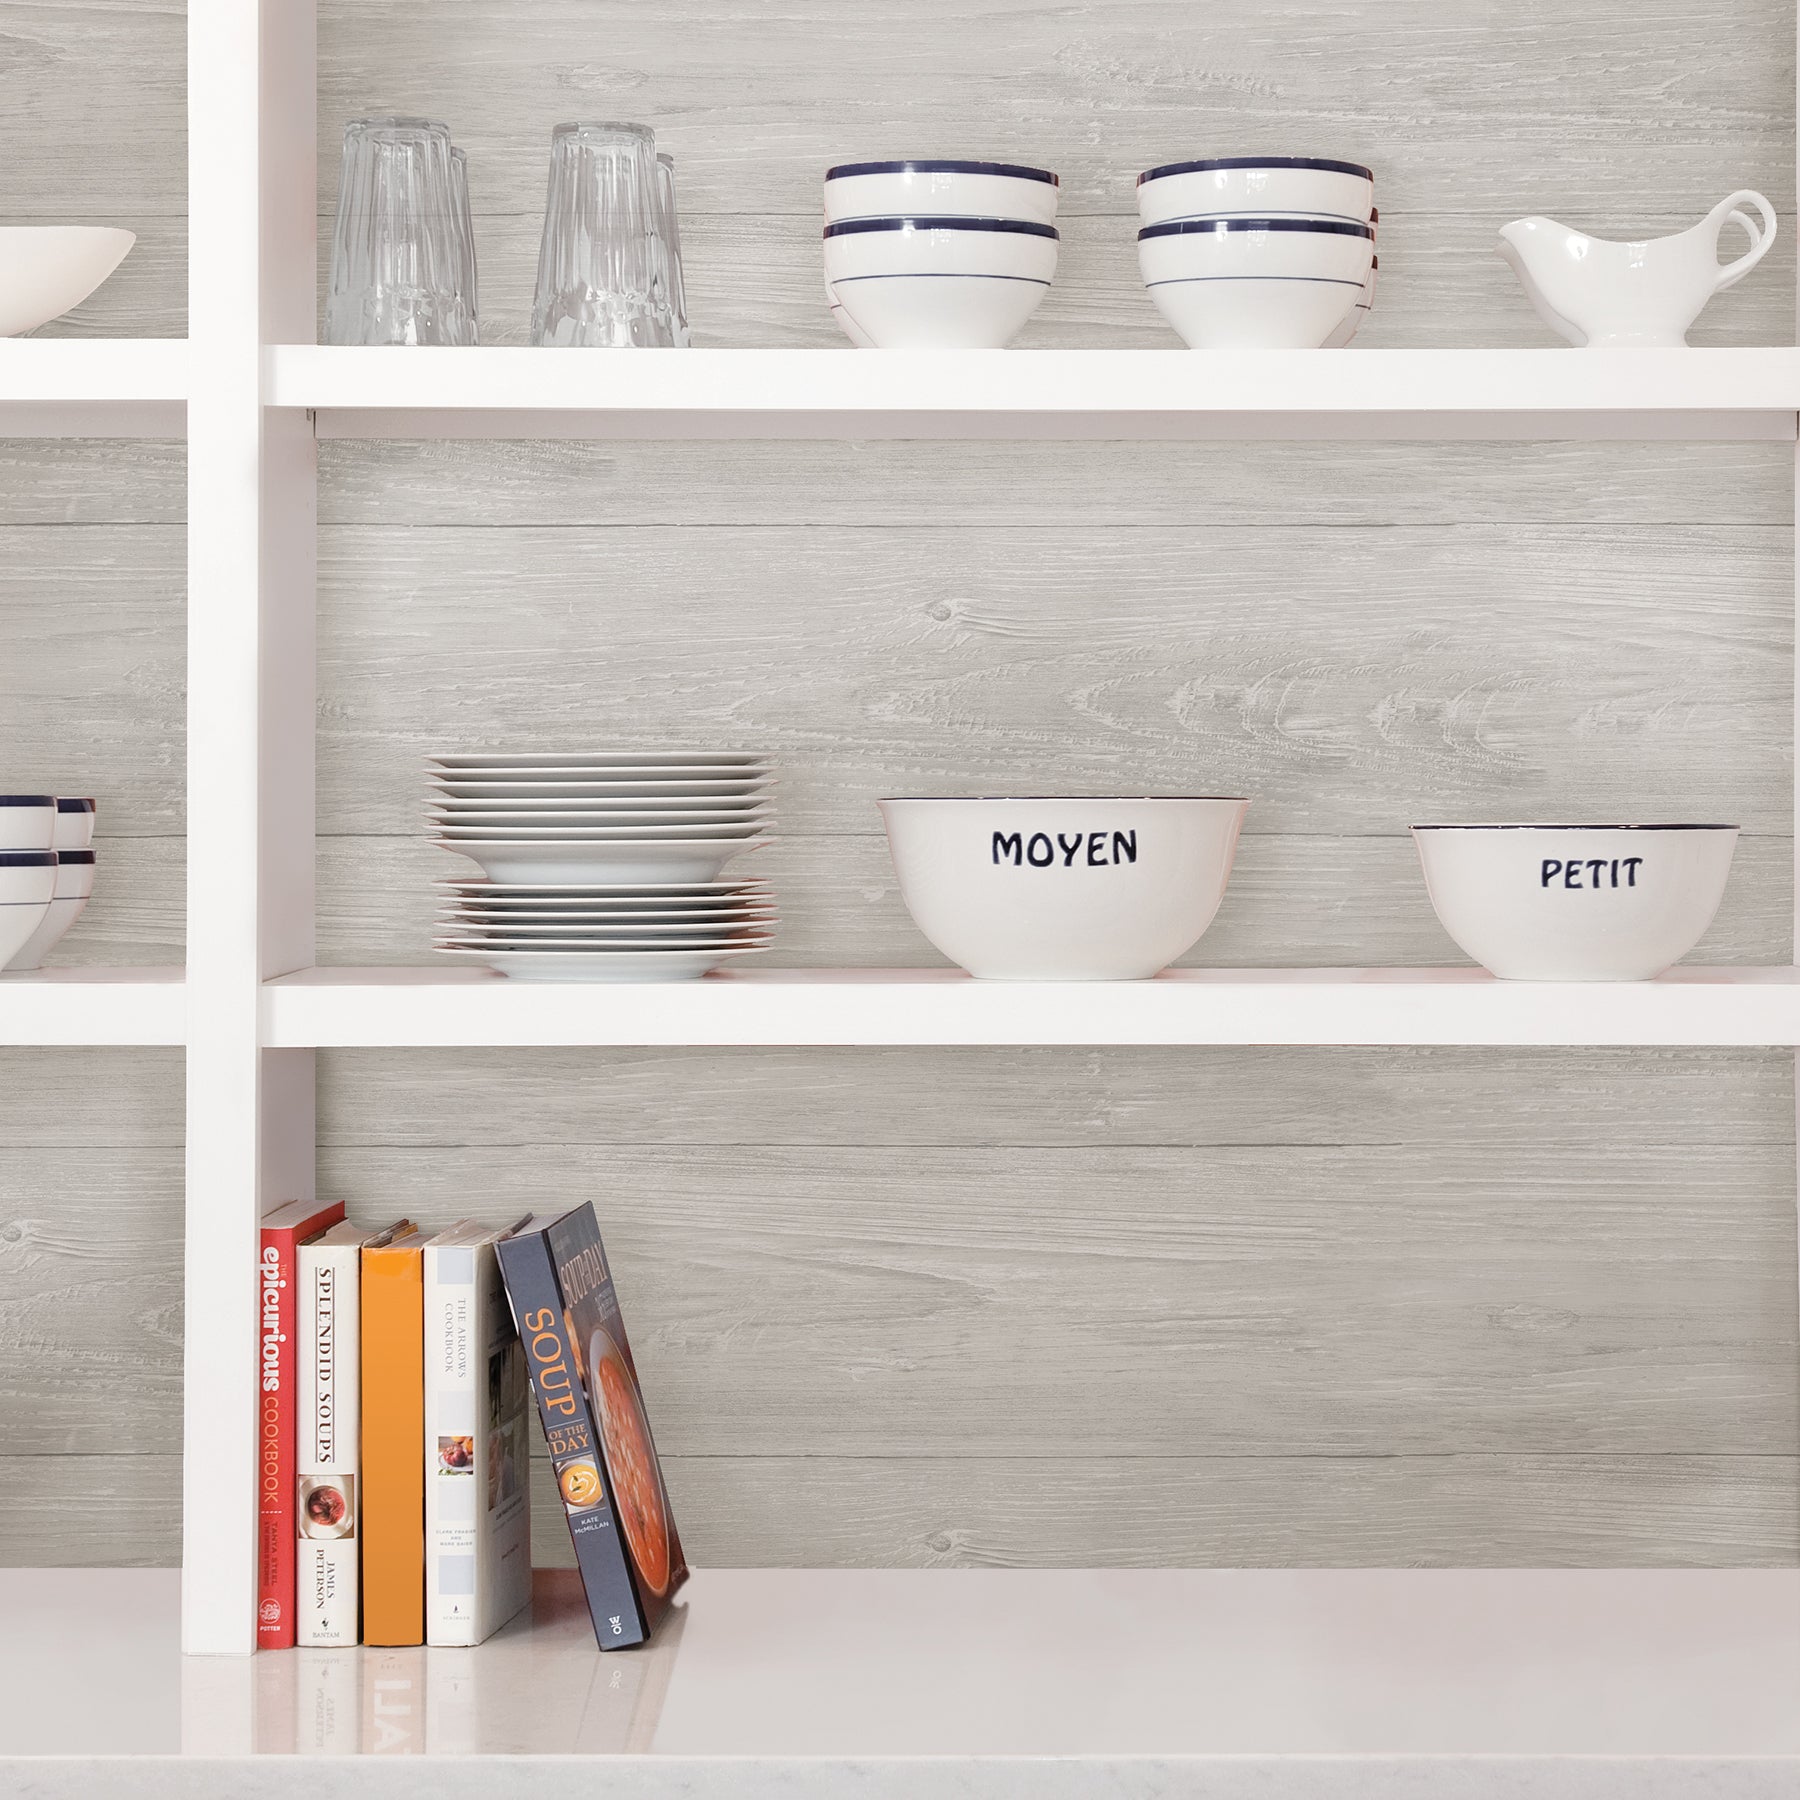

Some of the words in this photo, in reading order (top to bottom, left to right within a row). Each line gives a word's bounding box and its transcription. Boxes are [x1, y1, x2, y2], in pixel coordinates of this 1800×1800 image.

[992, 829, 1137, 867] MOYEN
[1541, 857, 1643, 888] PETIT
[260, 1246, 287, 1391] epicurious
[319, 1267, 331, 1382] SPLENDID
[457, 1297, 467, 1322] THE
[444, 1303, 454, 1373] COOKBOOK
[457, 1327, 467, 1378] ARROWS
[525, 1307, 577, 1416] SOUP
[319, 1392, 332, 1463] SOUPS
[548, 1429, 563, 1441] OF
[564, 1423, 587, 1437] THE
[551, 1433, 589, 1455] DAY
[264, 1396, 279, 1503] COOKBOOK
[574, 1521, 609, 1535] McMILLAN
[581, 1515, 599, 1525] KATE
[316, 1549, 325, 1609] PETERSON
[326, 1561, 335, 1599] JAMES
[312, 1631, 340, 1639] BANTAM
